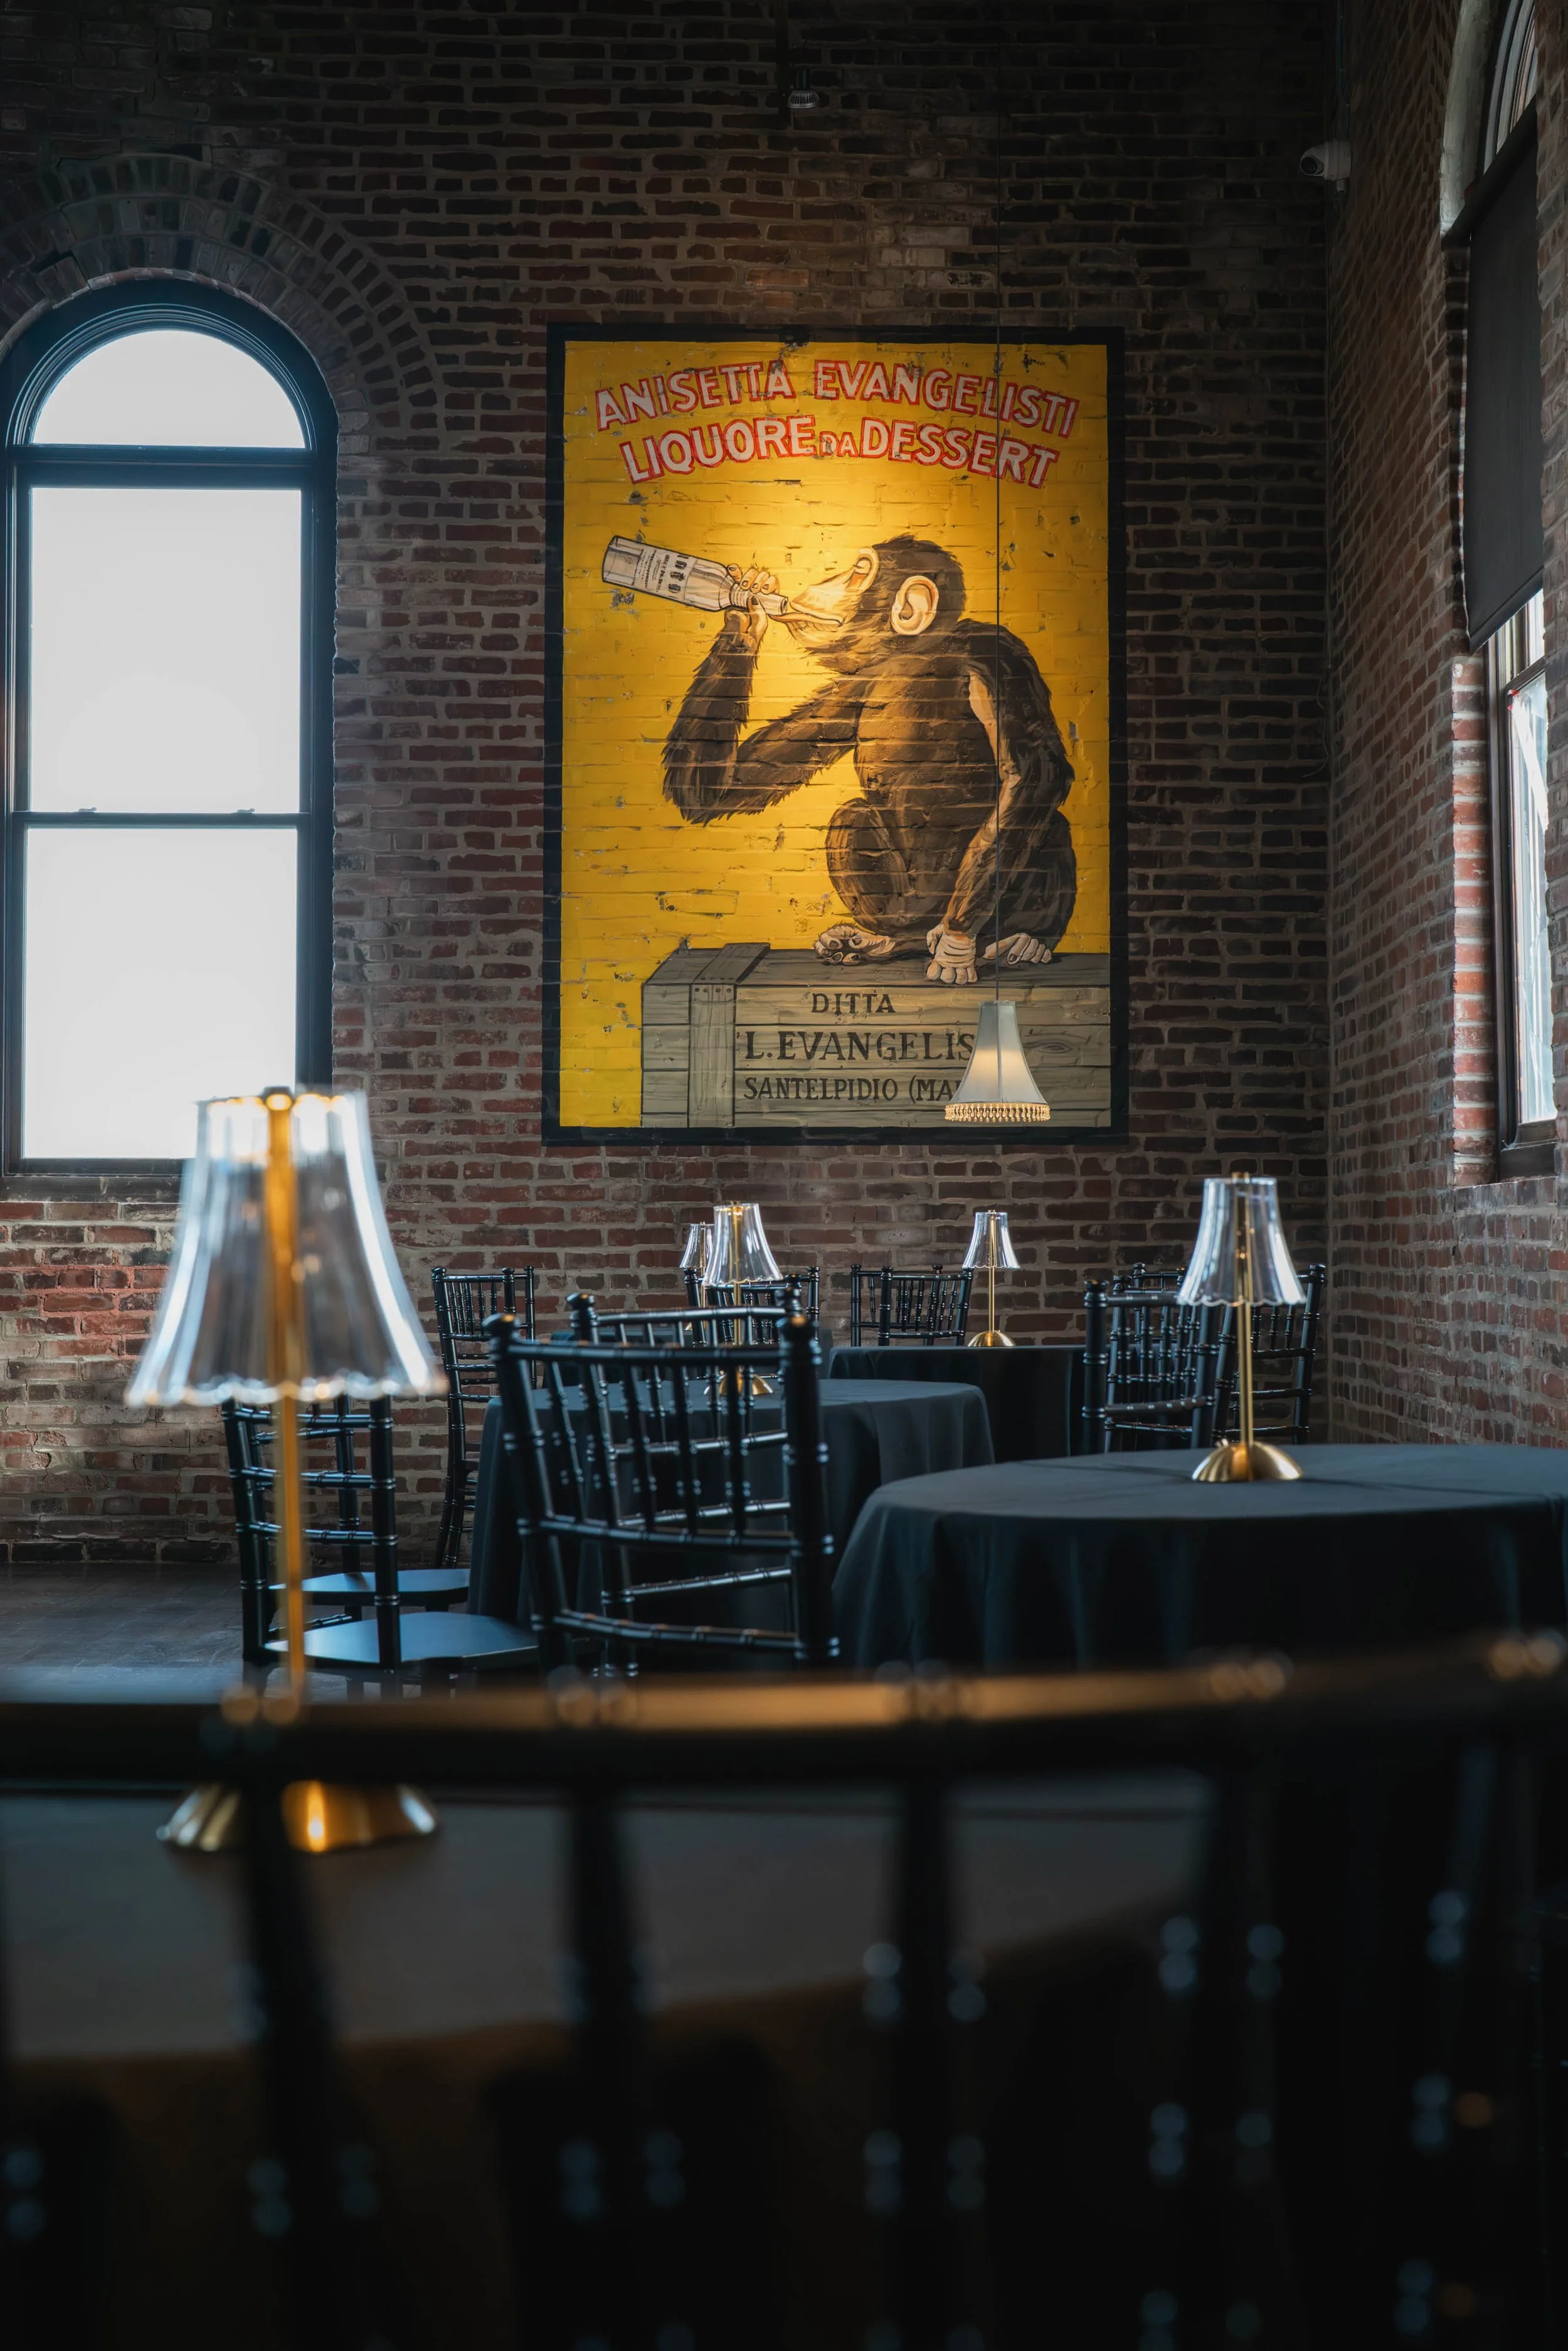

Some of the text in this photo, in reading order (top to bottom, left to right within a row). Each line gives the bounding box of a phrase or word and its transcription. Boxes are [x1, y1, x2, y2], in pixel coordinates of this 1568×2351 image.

[595, 359, 1079, 438] ANISETTA EVANGELISTI
[619, 415, 1059, 489] LIQUORE DA DESSERT
[812, 992, 895, 1015] DITTA
[744, 1075, 961, 1104] SANTELPIDIO (MA
